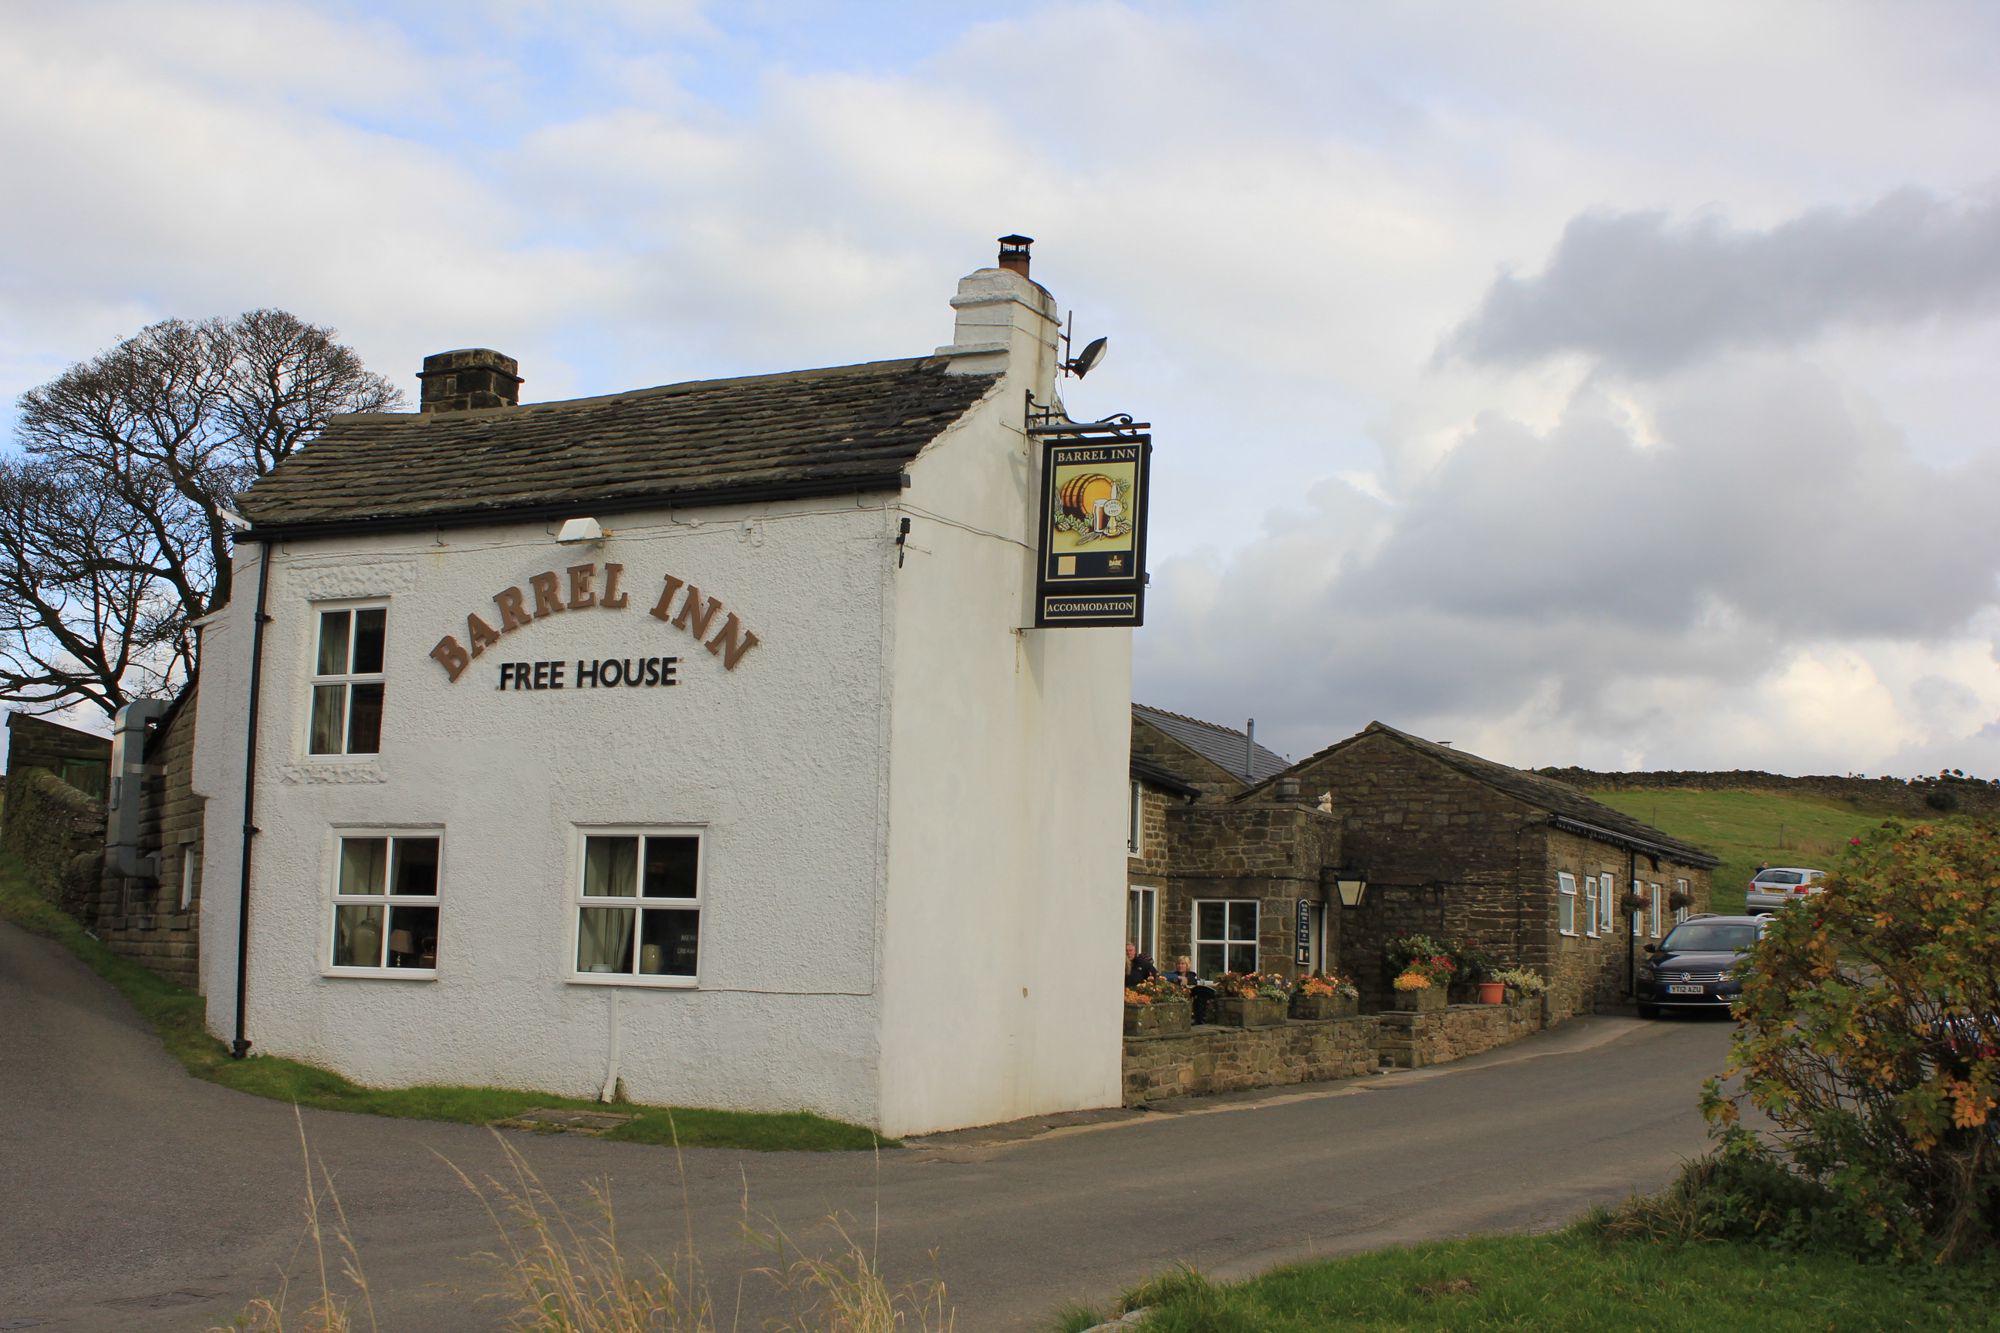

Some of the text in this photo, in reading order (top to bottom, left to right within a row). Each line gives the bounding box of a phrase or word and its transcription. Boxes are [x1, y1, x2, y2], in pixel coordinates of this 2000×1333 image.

[1057, 448, 1136, 462] BARREL INN
[1047, 602, 1133, 612] ACCOMMODATION
[429, 562, 760, 683] BARREL INN
[499, 656, 678, 690] FREE HOUSE
